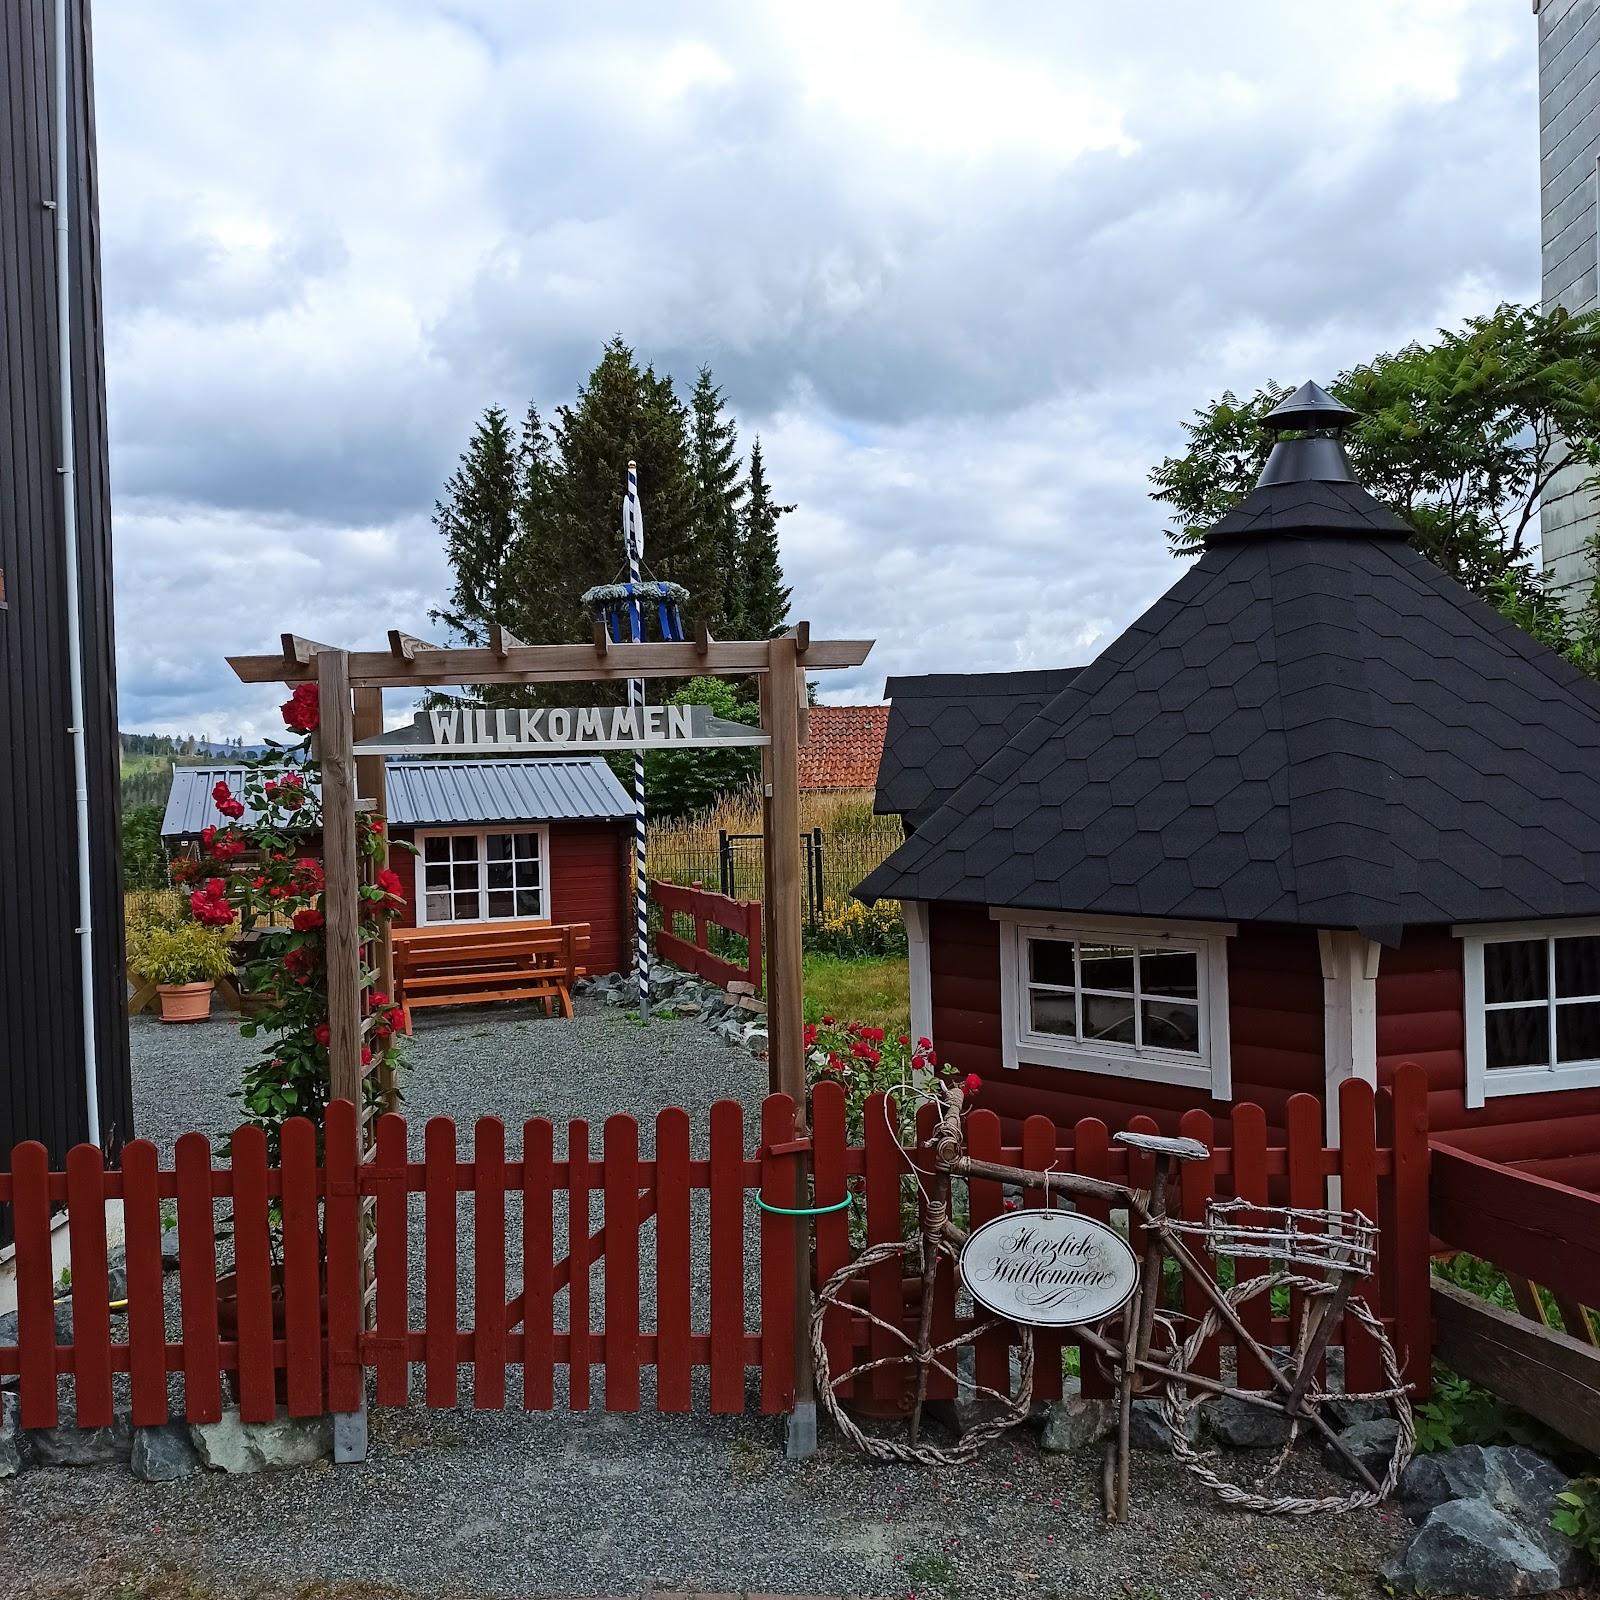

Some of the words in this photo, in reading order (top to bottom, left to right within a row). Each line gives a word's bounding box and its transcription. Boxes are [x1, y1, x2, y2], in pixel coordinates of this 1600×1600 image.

[429, 705, 692, 744] WILLKOMMEN
[1000, 1227, 1100, 1267] Herzlich
[975, 1255, 1116, 1290] Willkommen
